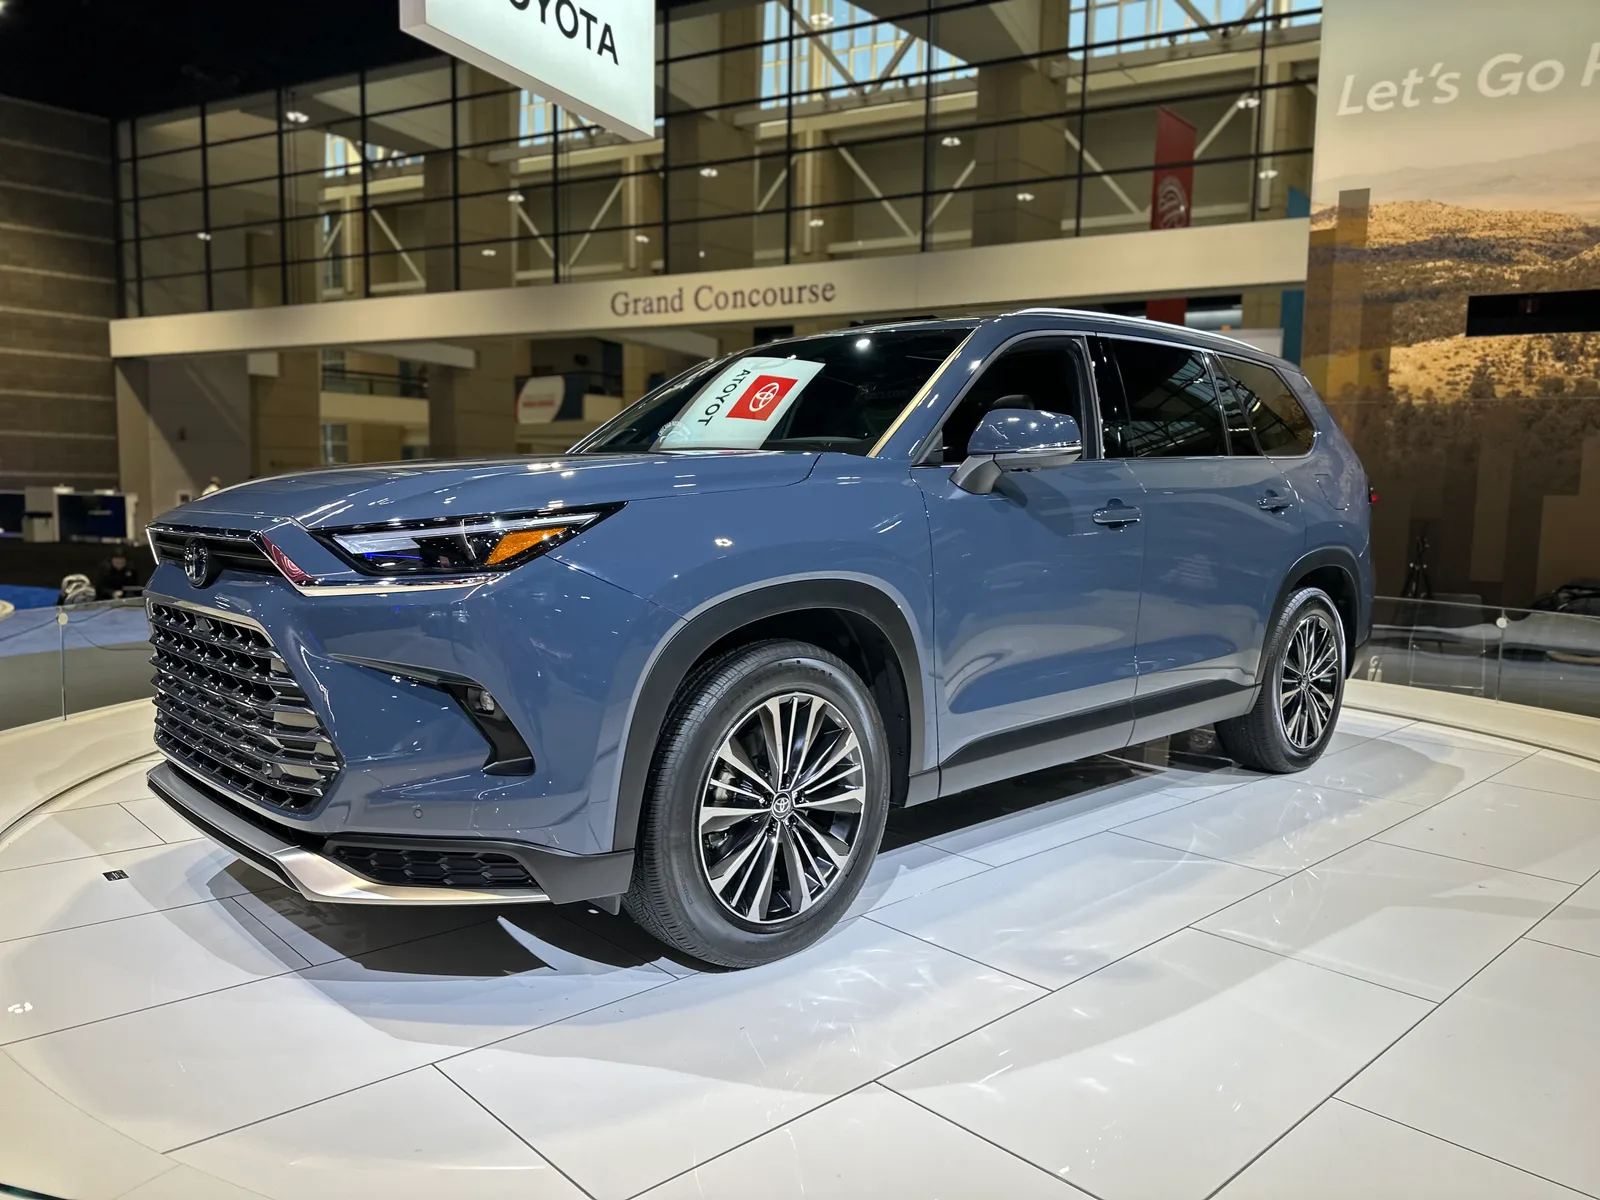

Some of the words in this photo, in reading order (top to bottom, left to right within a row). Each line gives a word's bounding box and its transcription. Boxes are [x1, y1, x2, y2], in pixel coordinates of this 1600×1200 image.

[509, 0, 619, 66] YOTA
[1337, 62, 1461, 116] Let's
[1477, 53, 1565, 98] Go
[611, 287, 684, 317] Grand
[694, 282, 836, 312] Concourse
